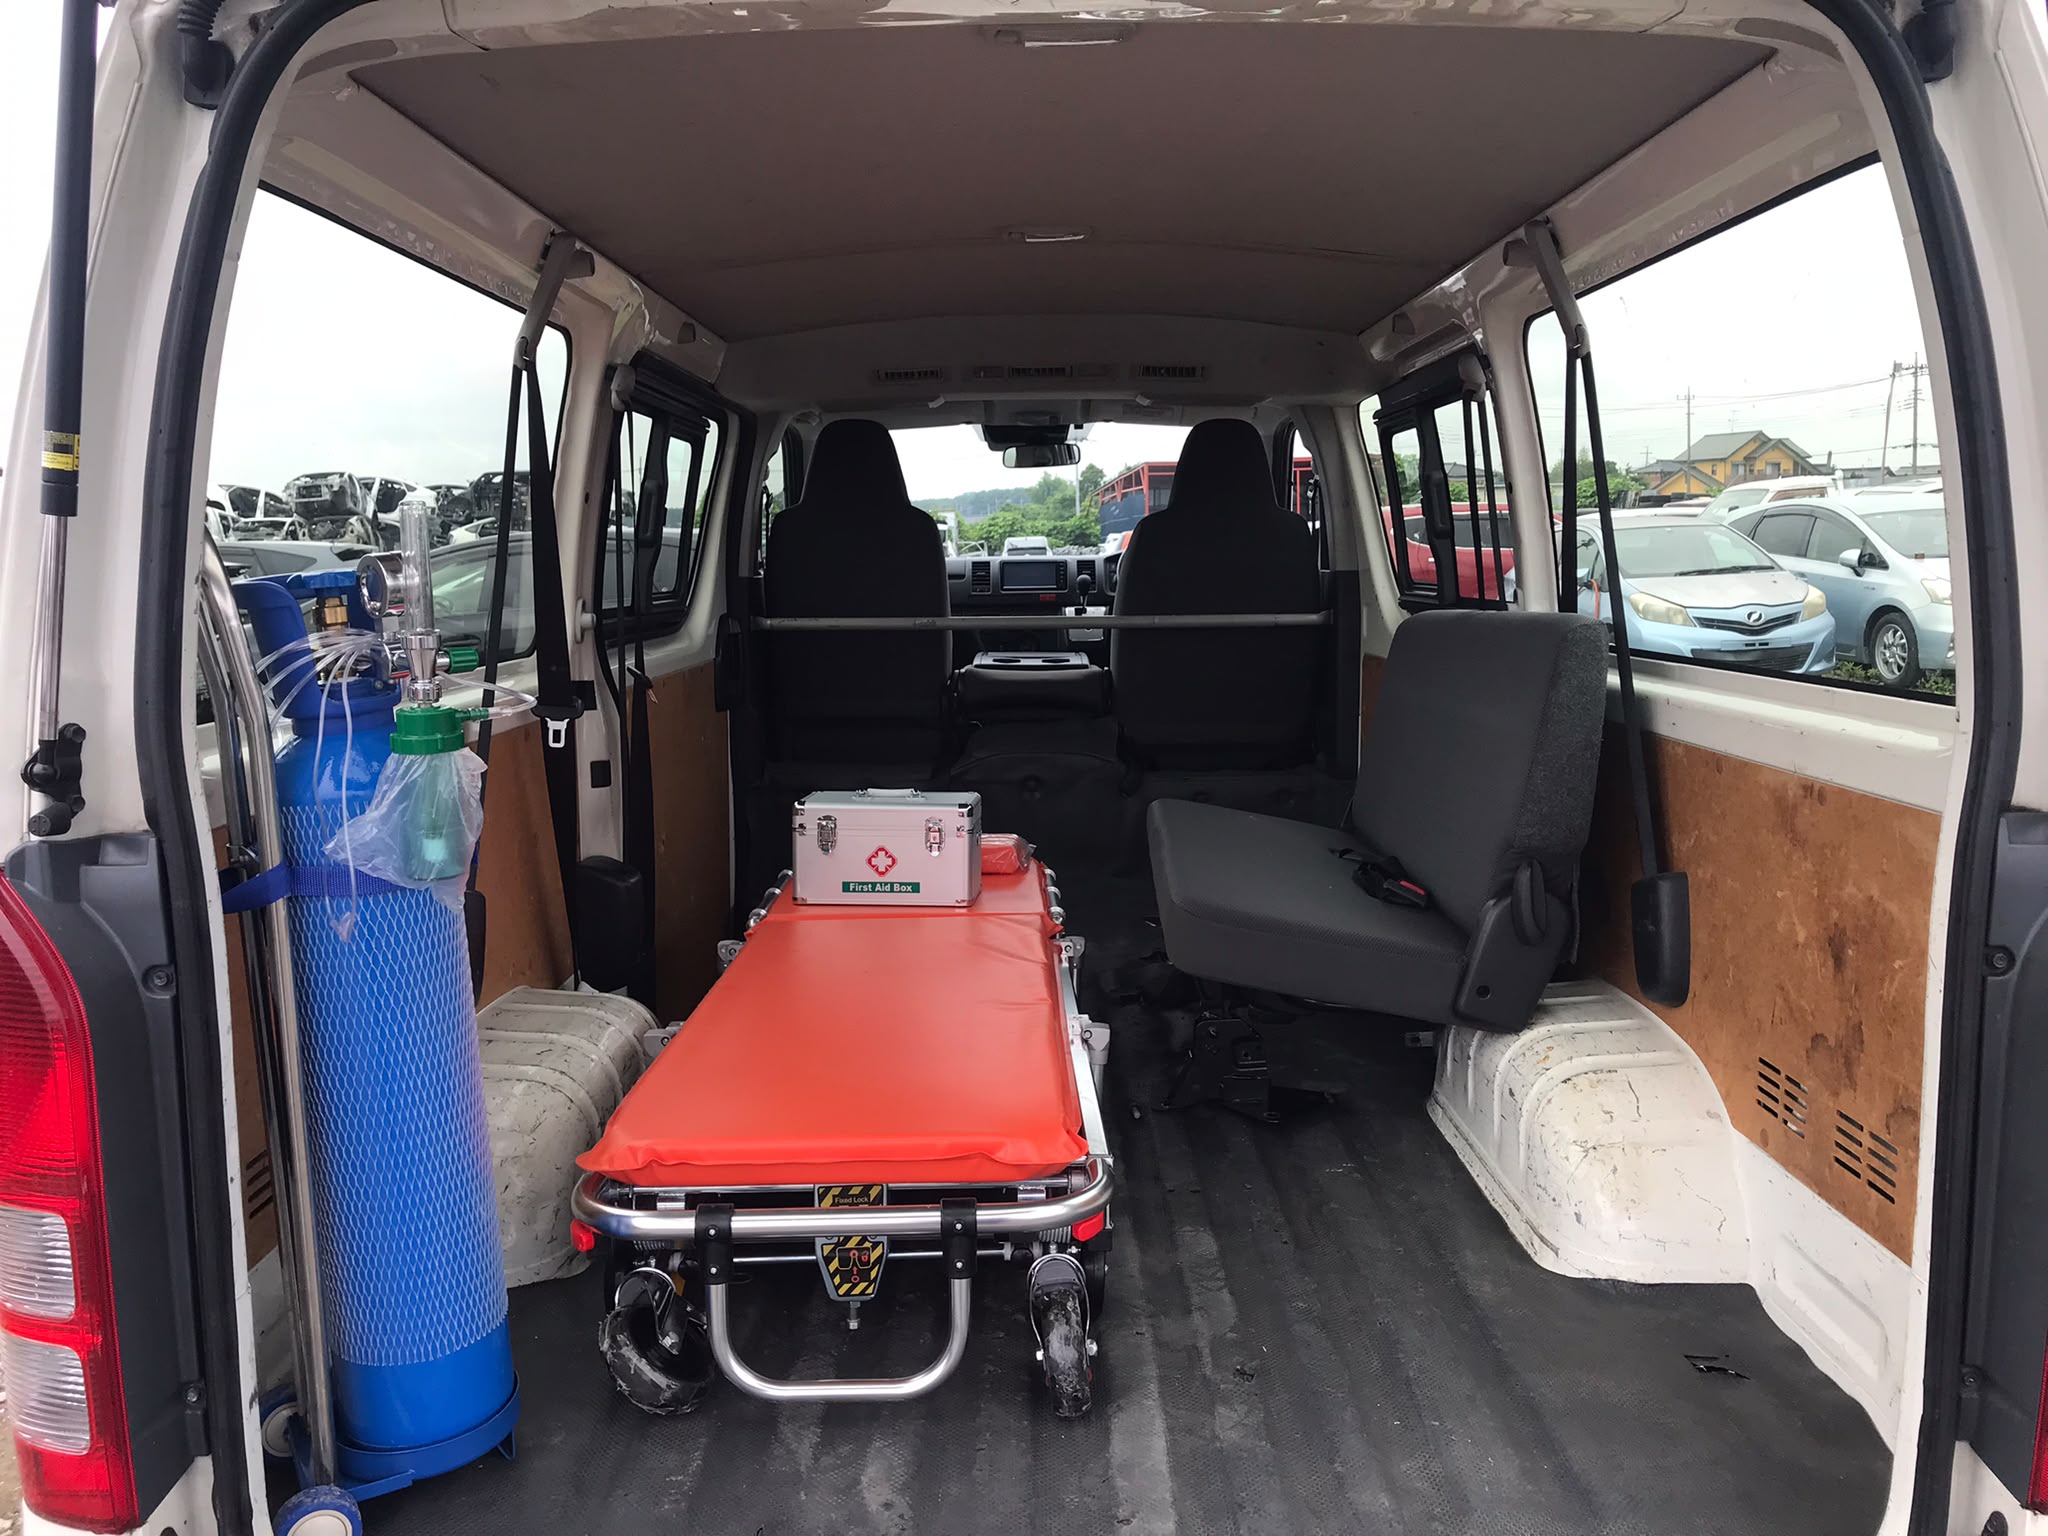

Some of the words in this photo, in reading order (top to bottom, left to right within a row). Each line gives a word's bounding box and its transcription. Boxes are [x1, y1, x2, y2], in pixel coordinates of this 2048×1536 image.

[849, 882, 873, 892] First
[874, 882, 891, 892] Aid
[893, 883, 913, 892] Box
